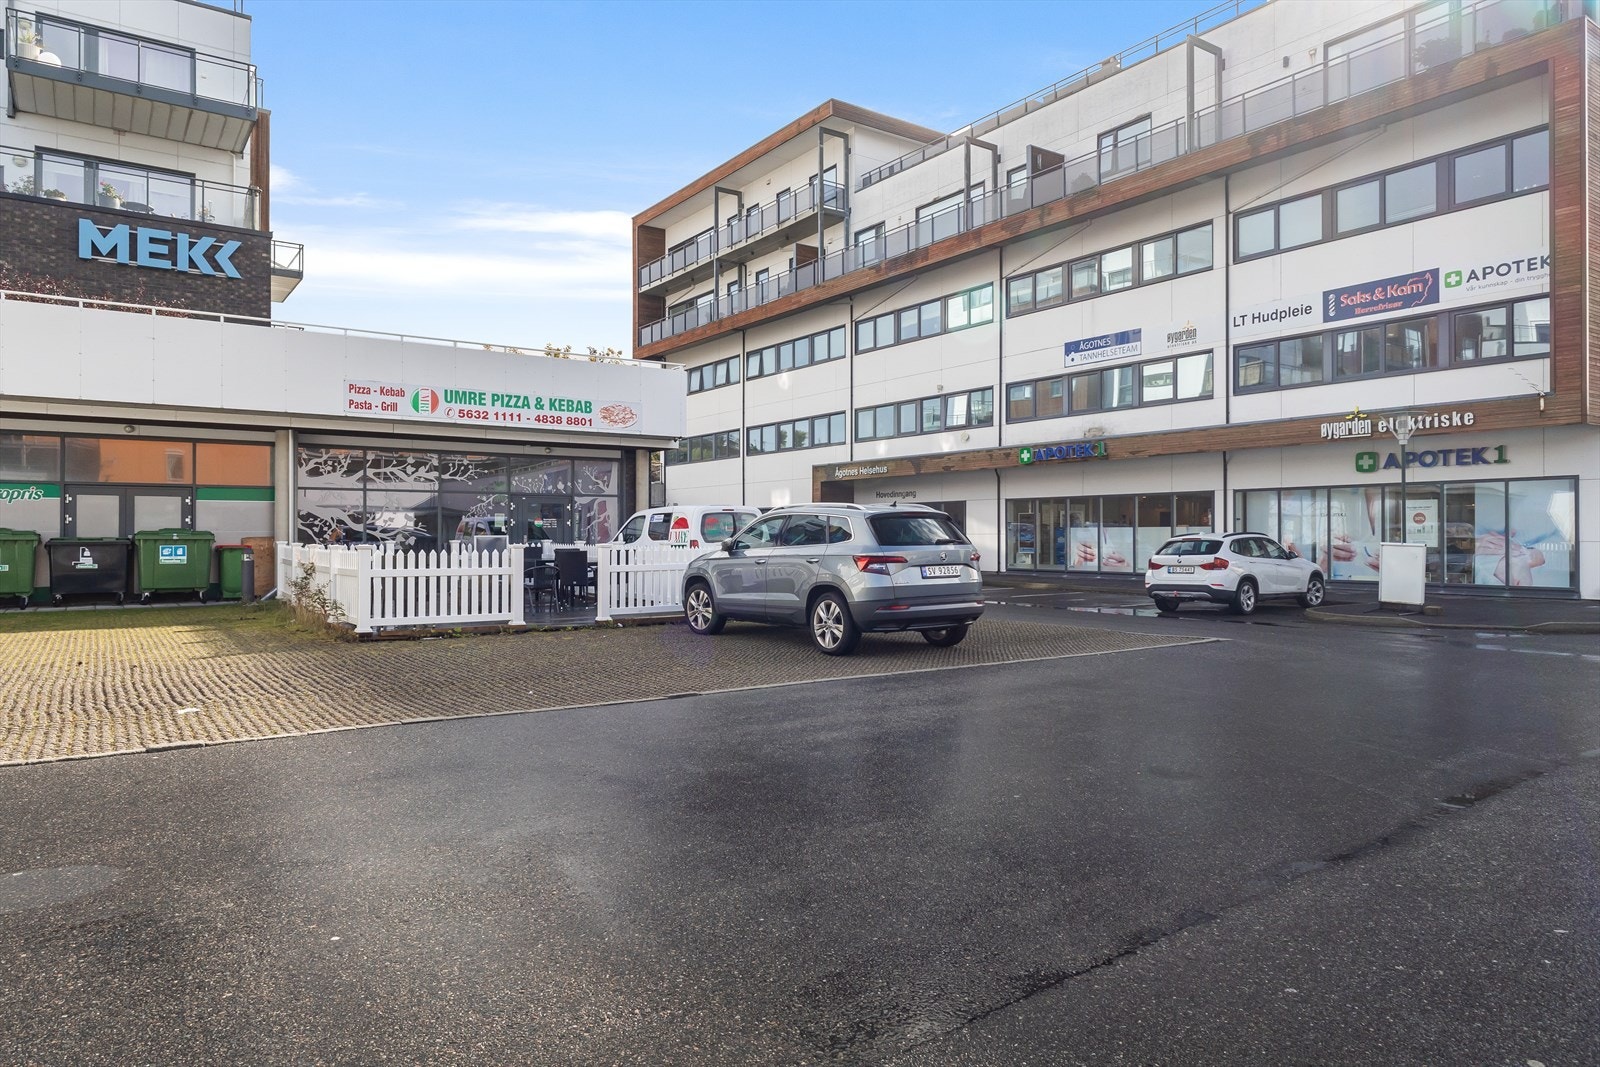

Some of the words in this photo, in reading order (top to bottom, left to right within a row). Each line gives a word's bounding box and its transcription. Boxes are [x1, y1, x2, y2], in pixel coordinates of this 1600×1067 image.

[1478, 280, 1508, 290] kunnskap
[1340, 290, 1372, 307] Saks
[1373, 288, 1385, 300] &
[1387, 281, 1424, 297] Kam
[1233, 314, 1247, 327] LT
[1252, 304, 1313, 324] Hudpleie
[1079, 337, 1112, 351] ÅGOTNES
[1079, 344, 1138, 362] TANNHELSETEAM
[349, 384, 371, 395] Pizza
[380, 386, 405, 398] Kebab
[348, 399, 372, 411] Pasta
[381, 401, 398, 412] Grill
[444, 389, 487, 406] UMRE
[491, 393, 531, 409] PIZZA
[534, 396, 545, 410] &
[549, 397, 593, 414] KEBAB
[458, 409, 489, 420] 5632
[493, 411, 522, 422] 1111
[534, 414, 563, 425] 4838
[566, 417, 593, 427] 8801
[1035, 443, 1094, 461] APOTEK
[1096, 440, 1107, 457] 1
[1383, 447, 1490, 469] APOTEK
[1494, 445, 1510, 464] 1
[835, 466, 858, 478] Ågotnes
[860, 465, 888, 475] Helsehus
[876, 490, 917, 499] Hovedinngang
[928, 567, 936, 576] SV
[939, 566, 959, 575] 92856
